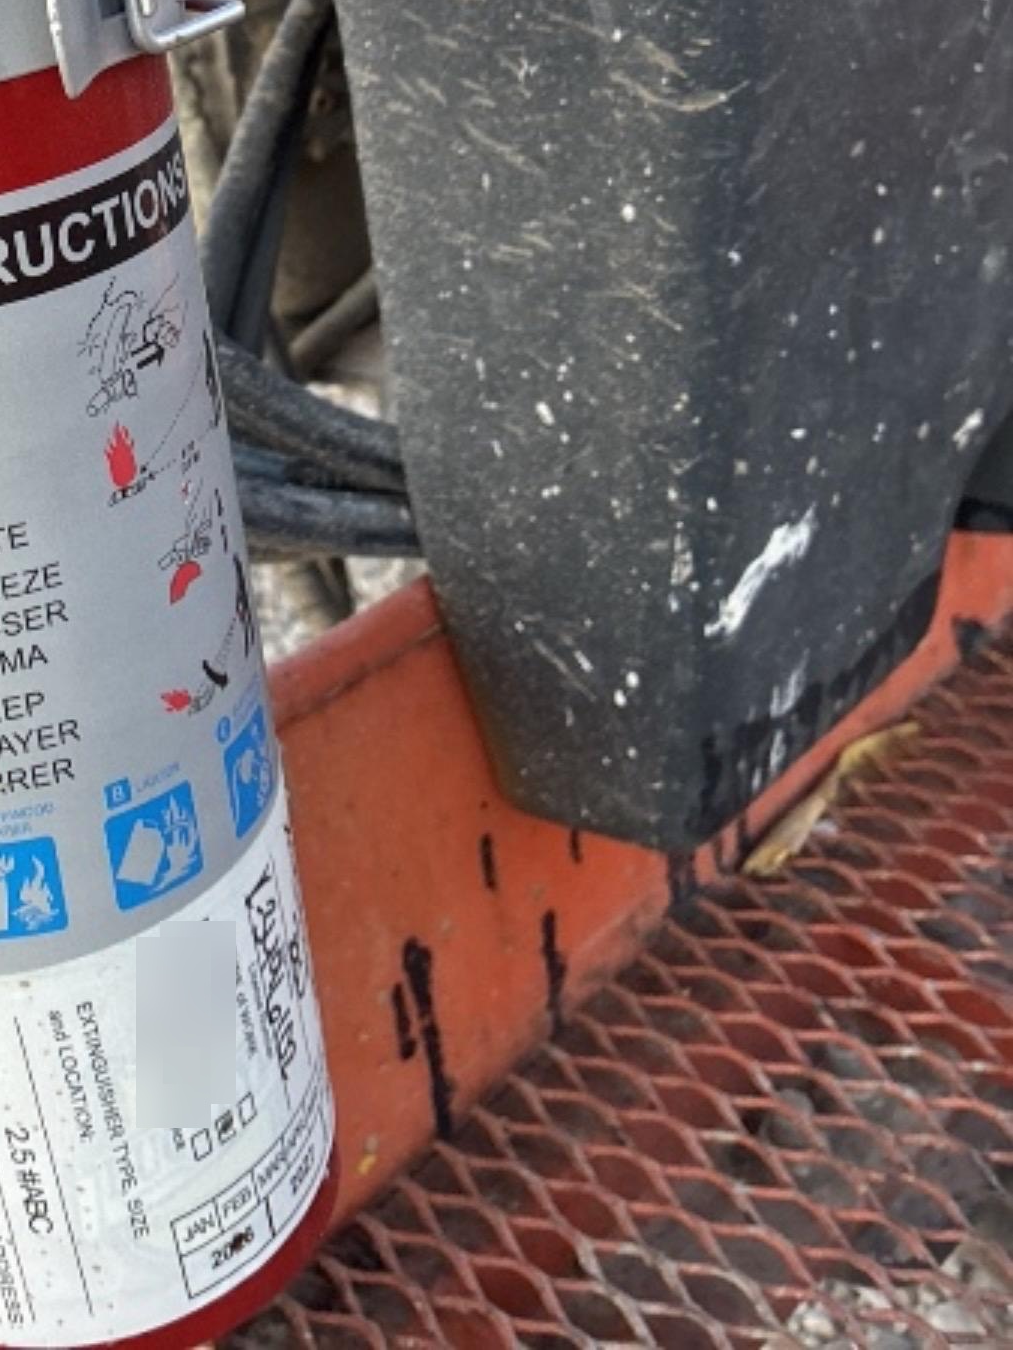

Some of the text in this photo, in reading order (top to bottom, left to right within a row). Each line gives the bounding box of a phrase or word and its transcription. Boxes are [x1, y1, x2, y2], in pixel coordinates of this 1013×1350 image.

[76, 1000, 125, 1140] EXTINGUISHER
[126, 1197, 149, 1239] SIZE
[183, 1212, 216, 1242] JAN
[211, 1225, 255, 1270] 206
